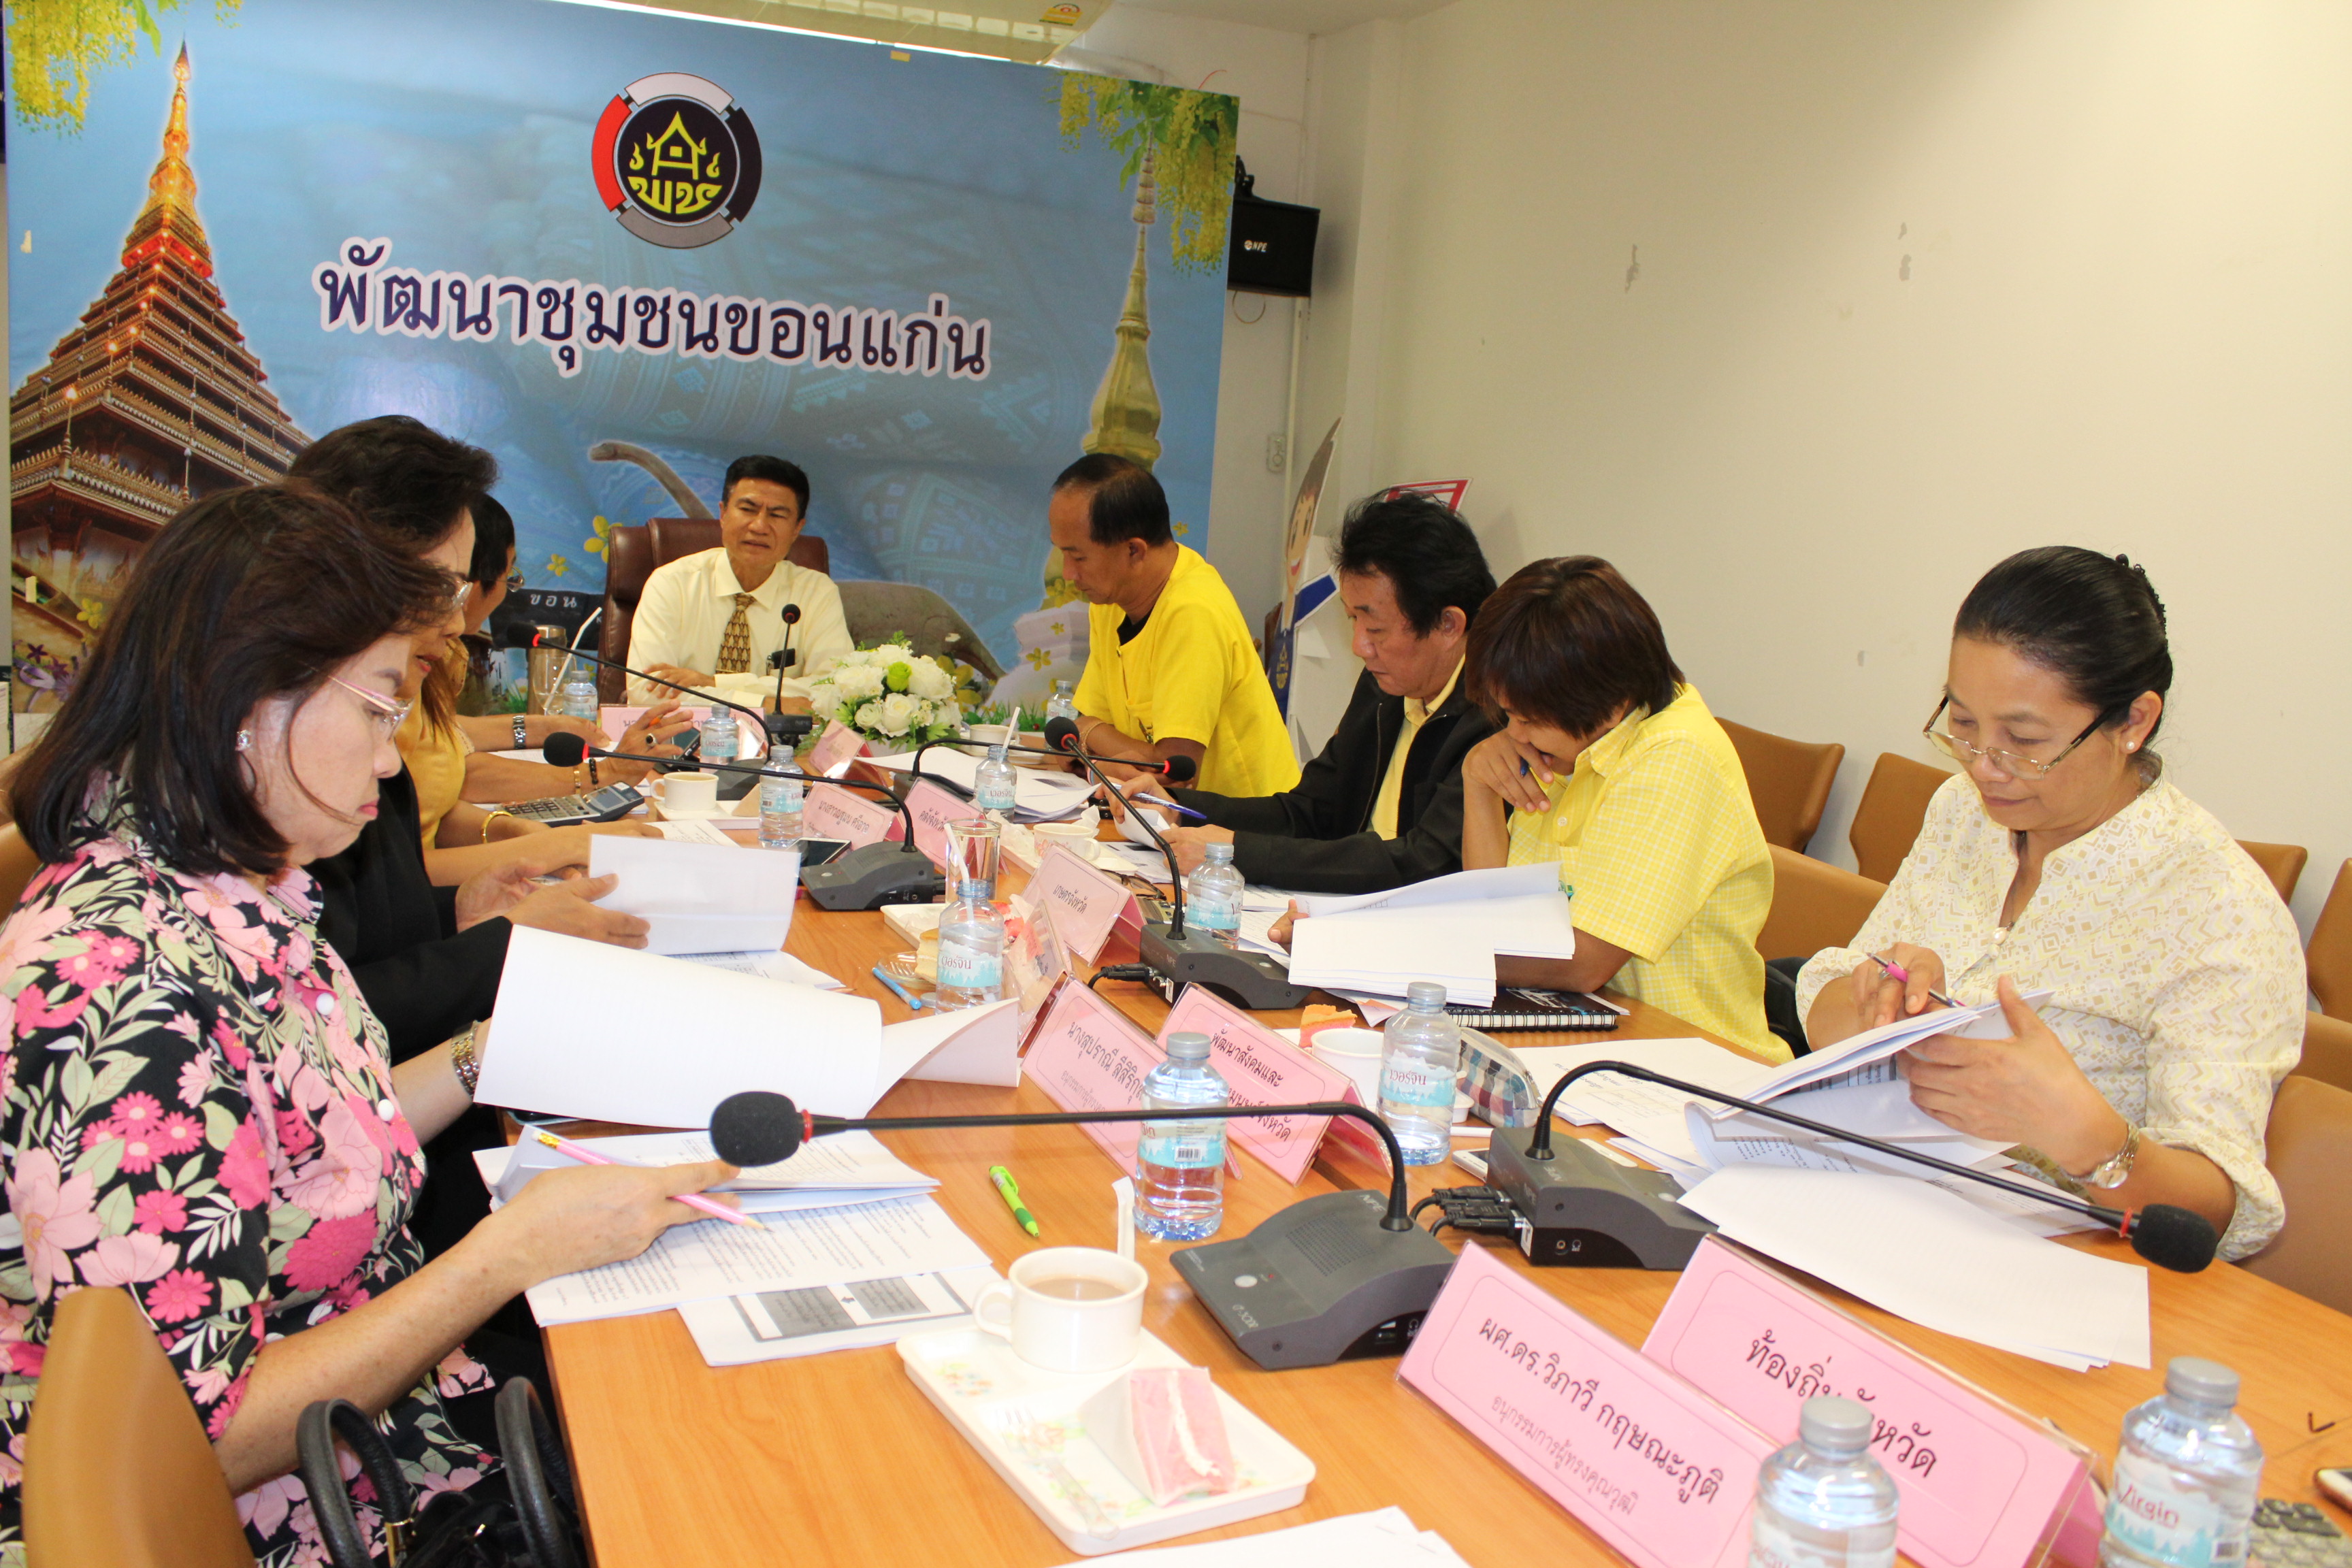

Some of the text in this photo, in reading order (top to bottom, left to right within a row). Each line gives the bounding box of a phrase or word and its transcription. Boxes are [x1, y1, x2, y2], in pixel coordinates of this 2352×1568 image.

[1252, 242, 1267, 252] NPE
[319, 243, 986, 374] พัฒนาชุมชนขอนแก่น
[1053, 883, 1088, 915] เกษตรจังหวัด
[941, 955, 972, 970] เวอร์จิน
[1067, 1022, 1120, 1072] นางสุปราณี
[1210, 1030, 1284, 1089] พัฒนาสังคมและ
[1389, 1068, 1427, 1085] เวอร์จิน
[1359, 1194, 1386, 1213] NPE
[1478, 1318, 1725, 1505] ผศ.ดร.วิภาวี กฤษณะภูติ
[1491, 1396, 1639, 1516] อนุกรรมการผู้ทรงคุณวุฒิ
[2114, 1472, 2180, 1529] Virgin
